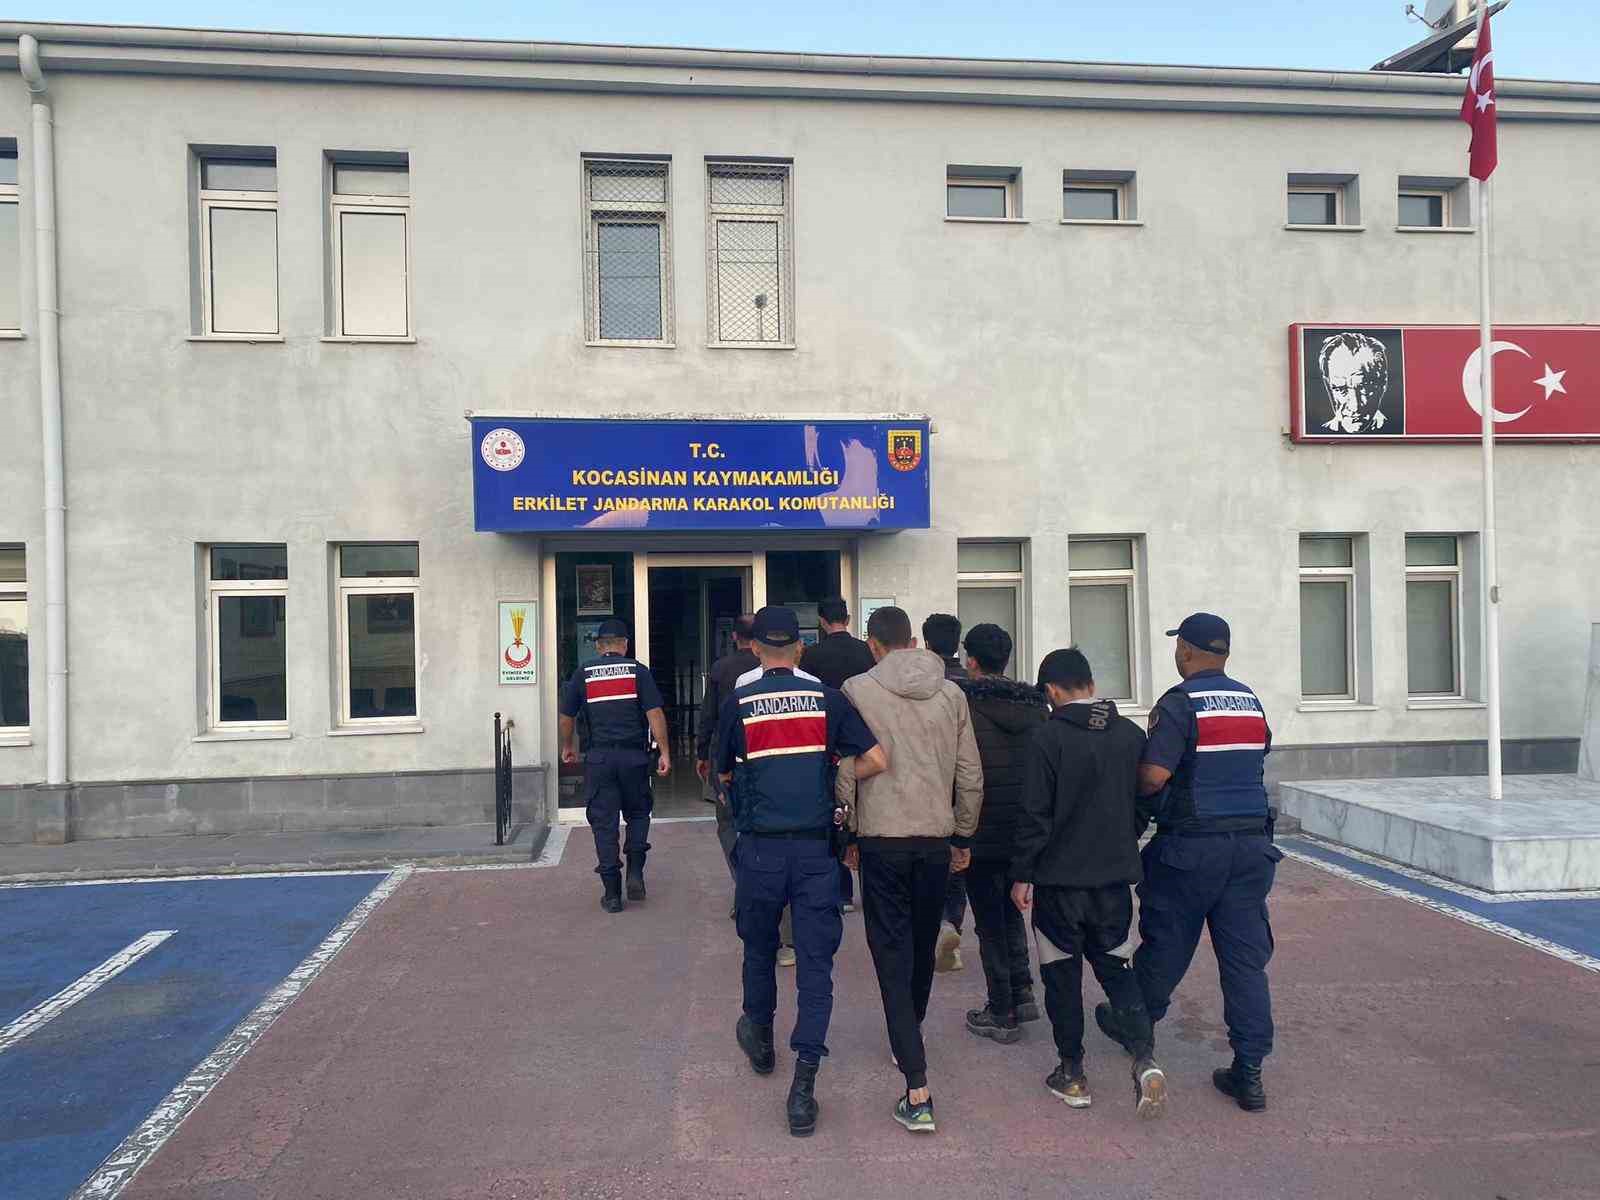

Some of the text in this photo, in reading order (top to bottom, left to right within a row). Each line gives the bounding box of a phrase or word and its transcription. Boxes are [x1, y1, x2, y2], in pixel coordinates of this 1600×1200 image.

[689, 443, 726, 458] T.C.
[572, 467, 839, 486] KOCASİNAN KAYMAKAMLIĞI
[512, 493, 895, 511] ERKİLET JANDARMA KARAKOL KOMUTANLIĞI
[590, 666, 630, 679] JANDARMA
[750, 696, 820, 717] JANDARMA
[1202, 696, 1258, 711] JANDARMA
